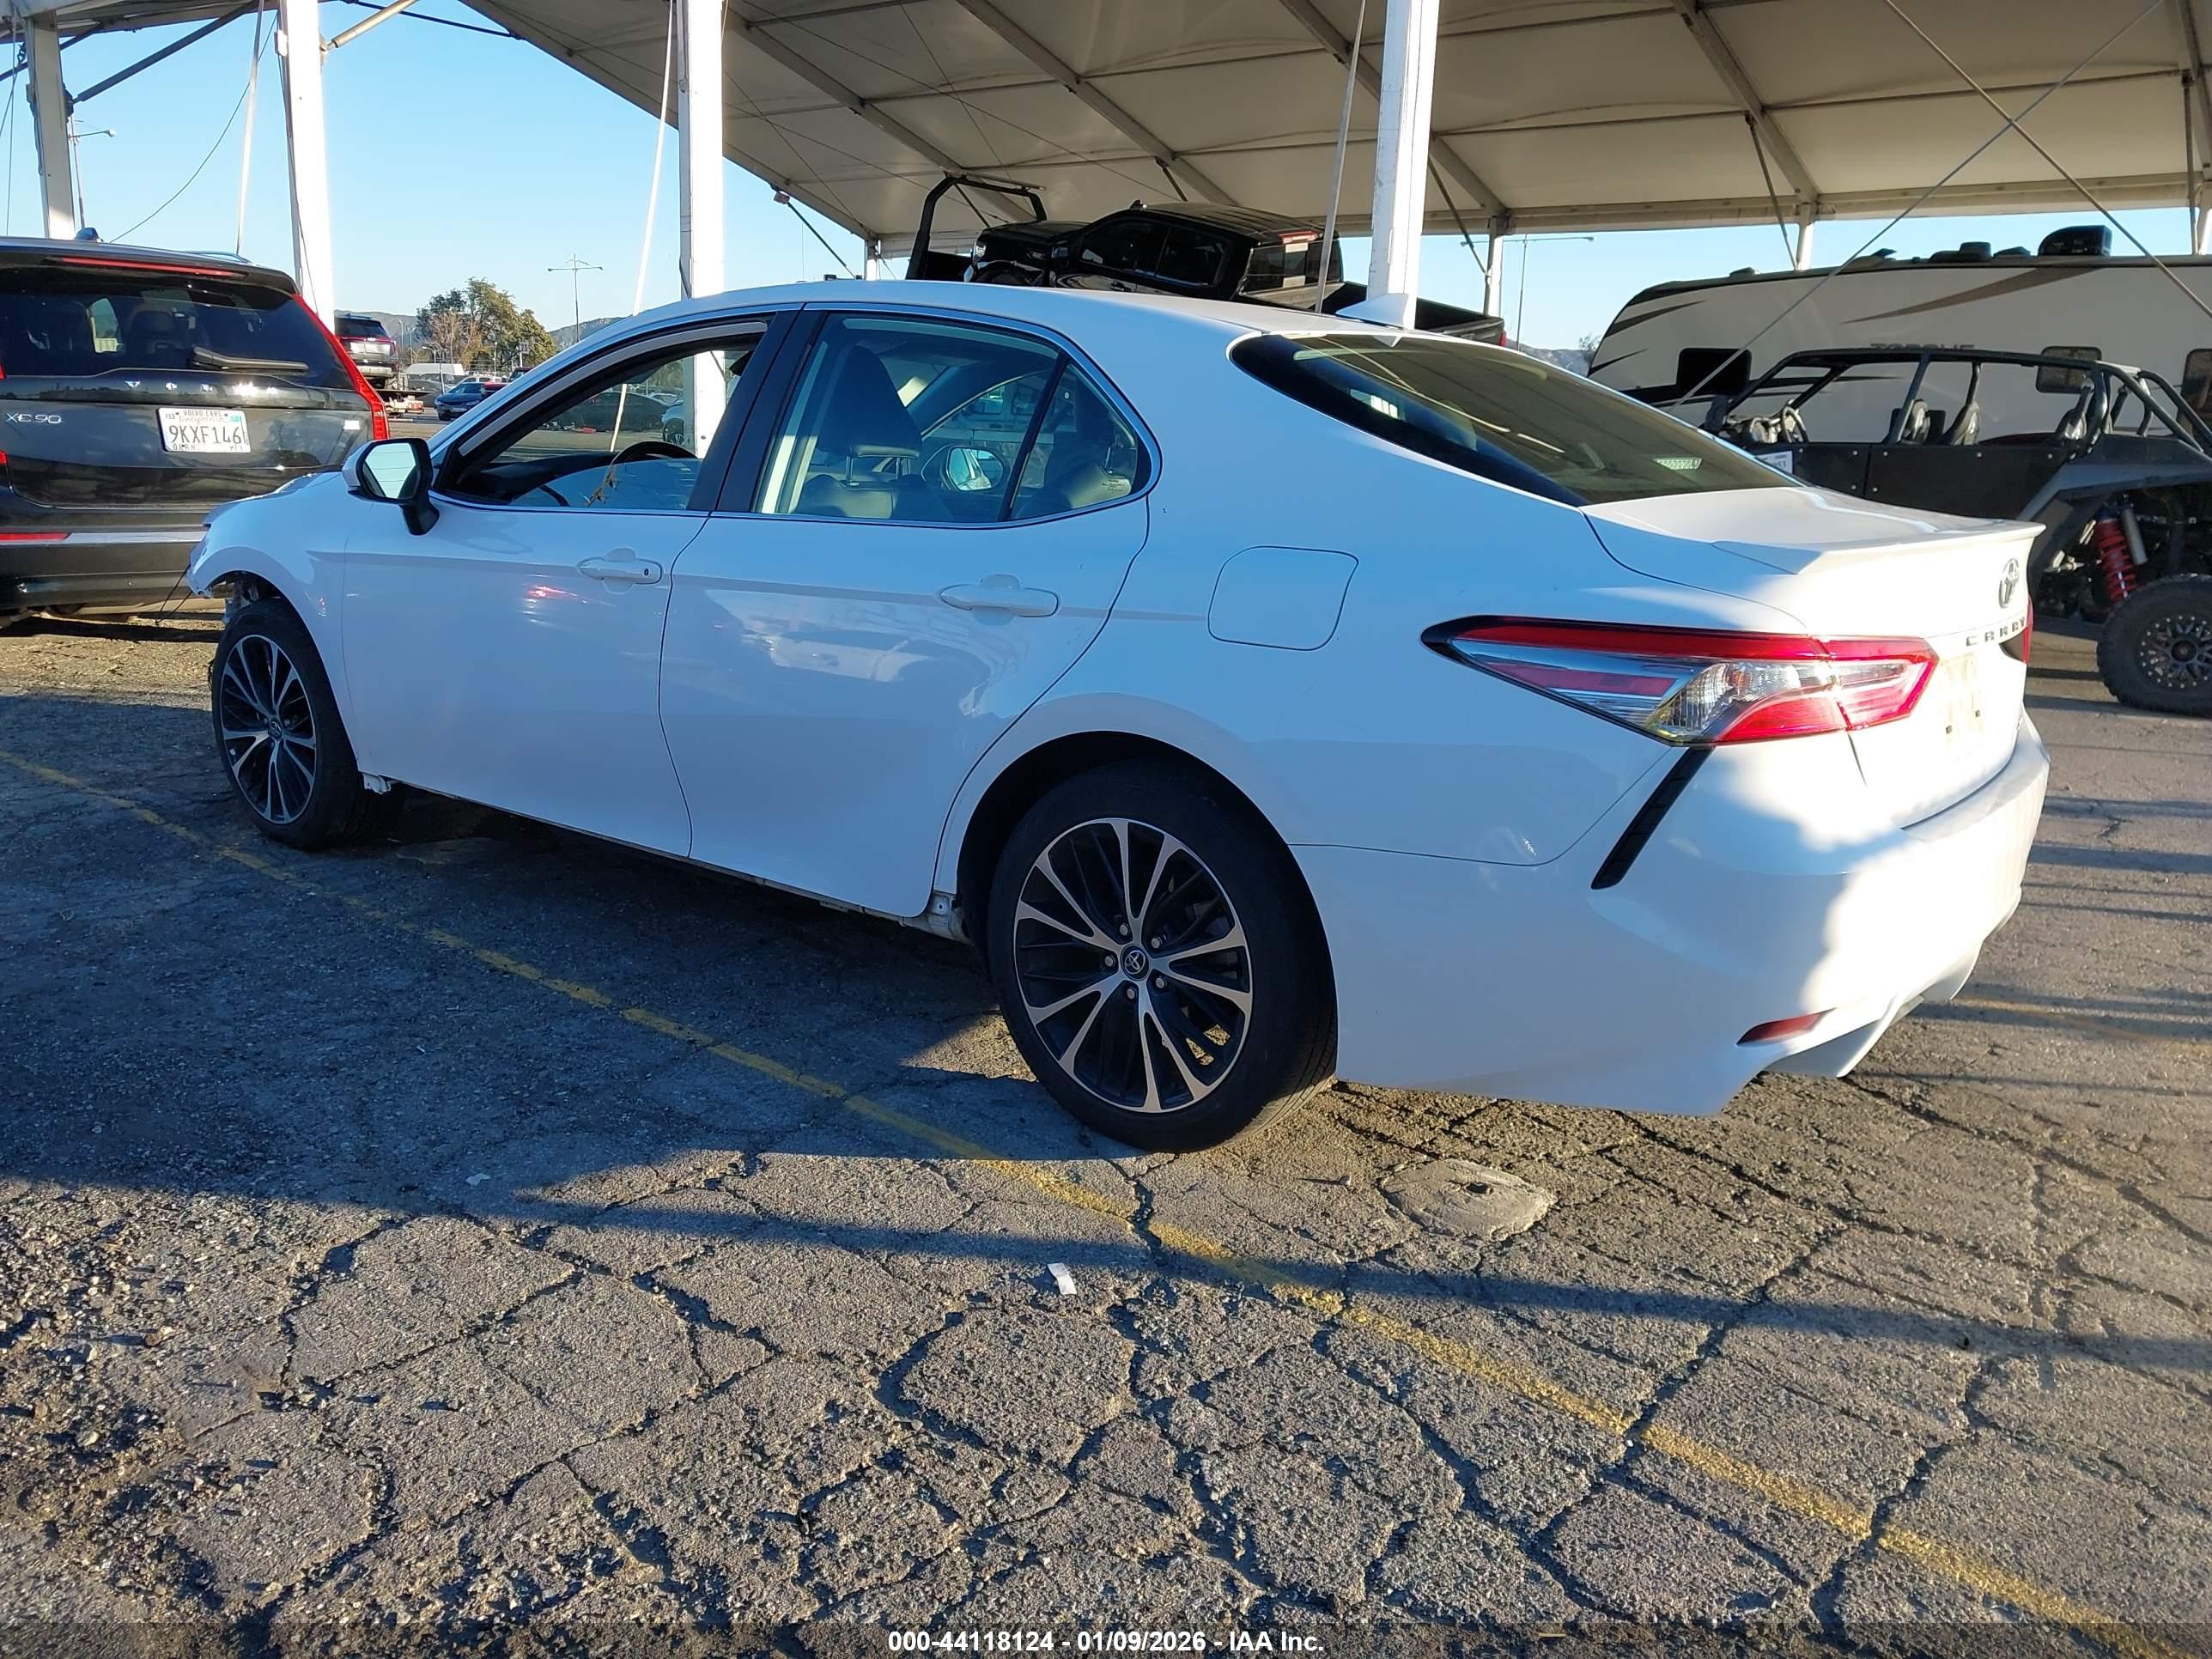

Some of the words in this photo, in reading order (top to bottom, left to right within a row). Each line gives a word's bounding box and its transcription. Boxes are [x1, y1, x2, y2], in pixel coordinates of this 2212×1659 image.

[5, 413, 63, 425] XC90
[168, 425, 242, 445] 9KXF146
[1966, 617, 2026, 647] CAMRY
